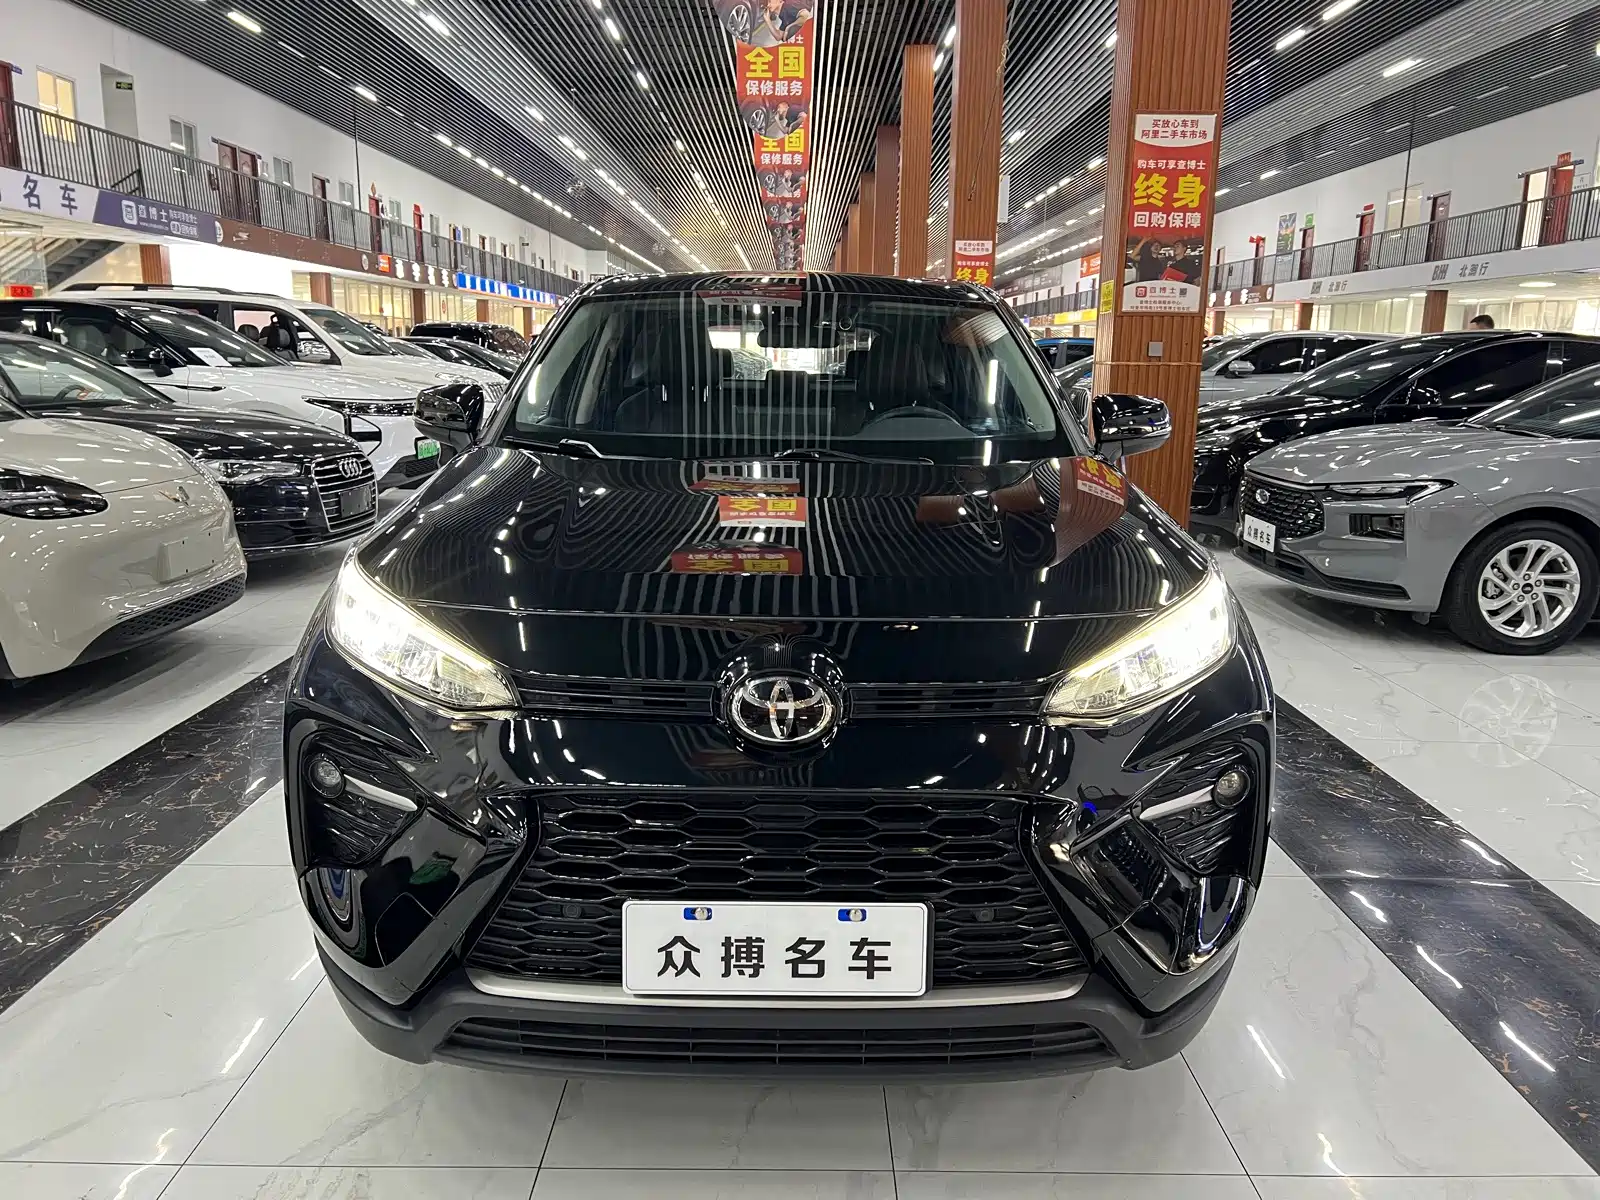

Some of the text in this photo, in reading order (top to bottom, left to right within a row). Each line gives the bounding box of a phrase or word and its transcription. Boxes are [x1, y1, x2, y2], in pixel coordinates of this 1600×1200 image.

[744, 46, 805, 79] 全国
[745, 80, 804, 96] 保修服务
[1151, 118, 1200, 129] 买放心车到
[1141, 129, 1208, 140] 阿里二手车市场
[760, 153, 804, 164] 保修服务
[1136, 159, 1206, 170] 购车可享查博士
[0, 173, 78, 216] 名车
[1133, 173, 1206, 208] 终身
[1133, 211, 1202, 229] 回购保障
[955, 267, 990, 285] 终身
[656, 934, 892, 981] 众搏名车
